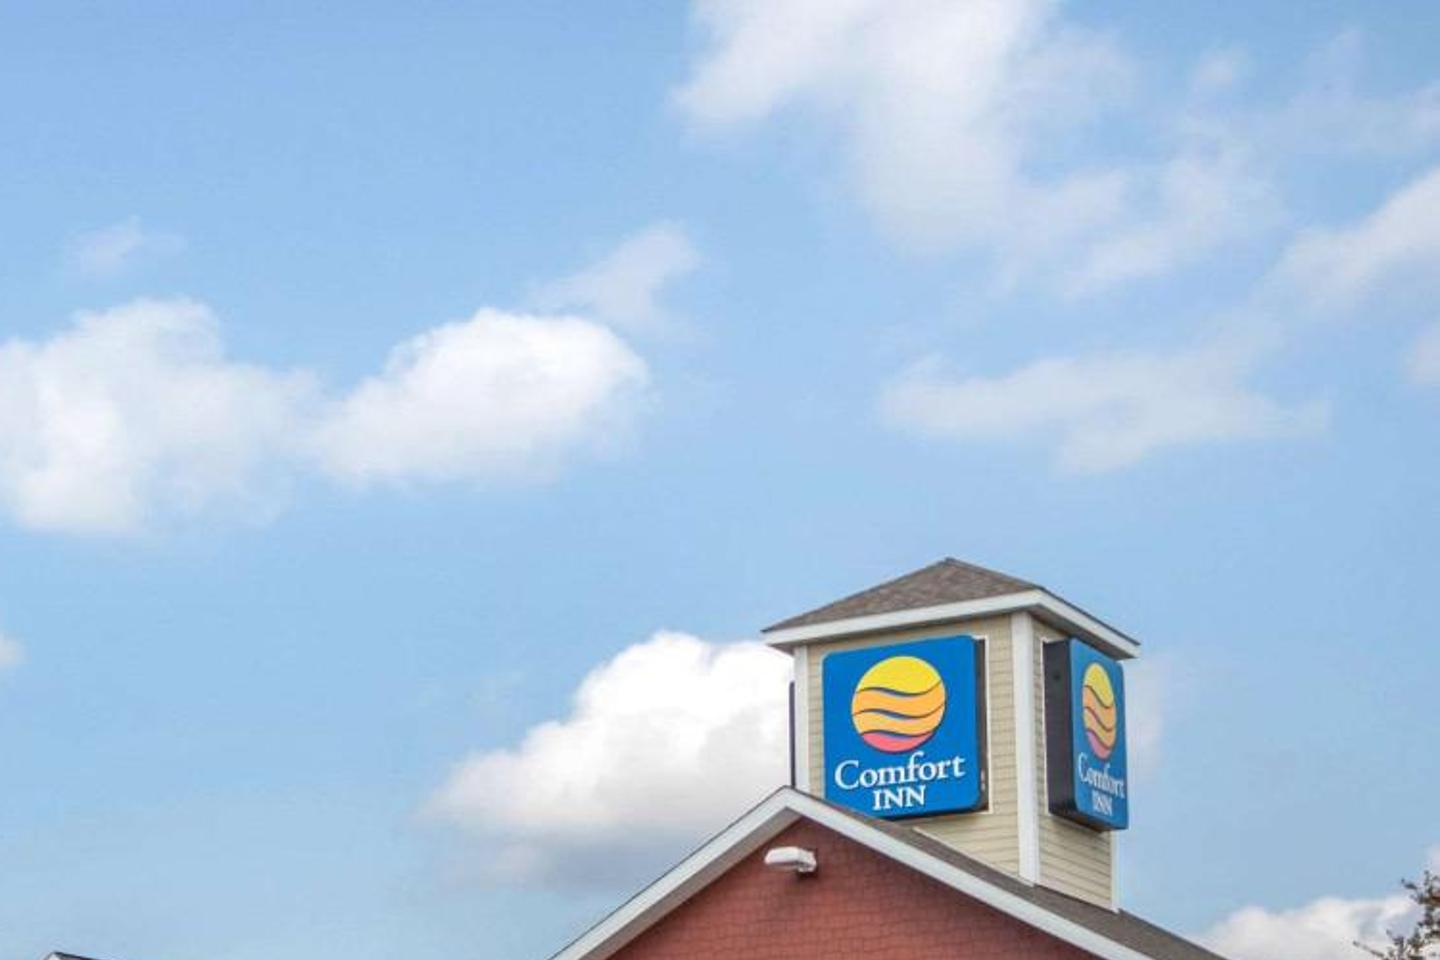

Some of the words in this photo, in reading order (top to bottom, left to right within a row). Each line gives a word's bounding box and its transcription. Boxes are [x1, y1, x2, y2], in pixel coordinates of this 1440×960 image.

[835, 751, 965, 790] Comfort
[1078, 752, 1125, 799] Comfort
[872, 785, 926, 810] INN
[1092, 789, 1113, 816] INN
